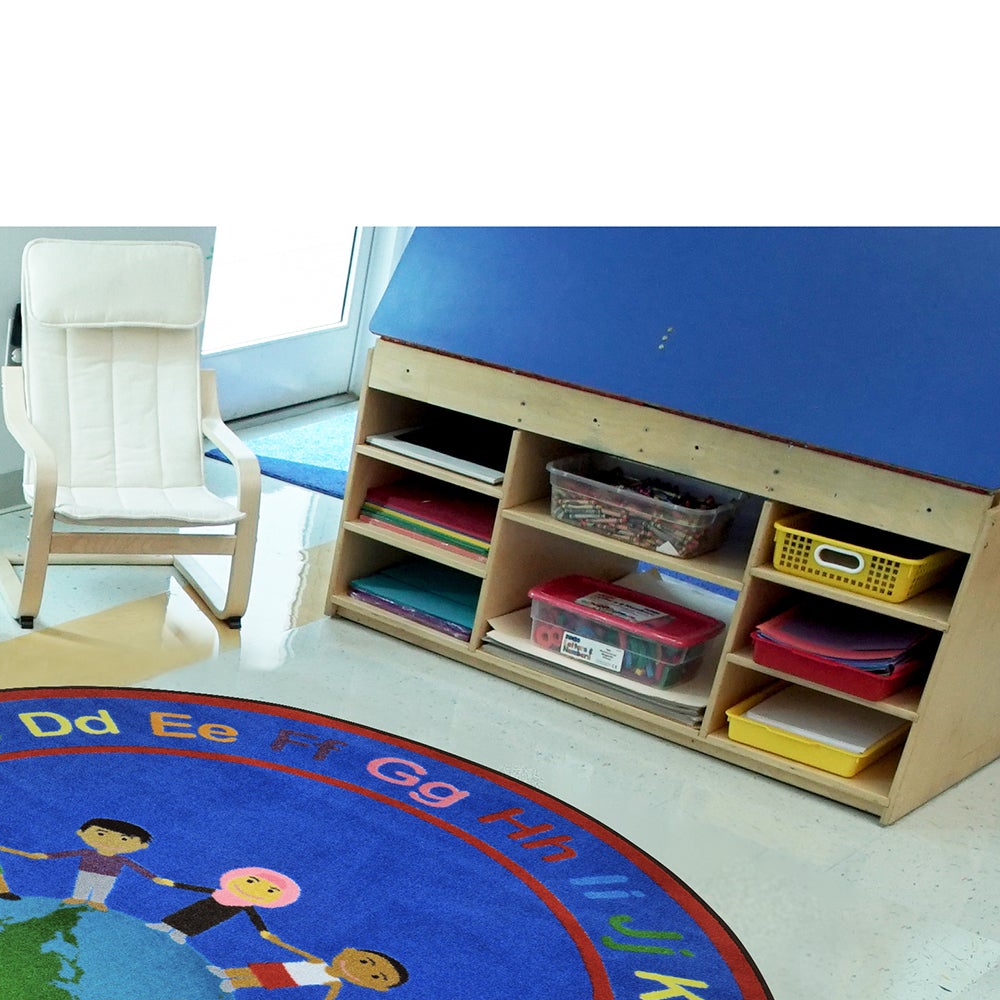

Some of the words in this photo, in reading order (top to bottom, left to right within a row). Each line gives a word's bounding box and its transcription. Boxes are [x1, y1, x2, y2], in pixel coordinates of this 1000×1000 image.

[18, 709, 120, 738] Dd
[149, 711, 239, 744] Ee
[270, 729, 349, 762] Ff
[366, 757, 471, 808] Gg
[477, 807, 577, 863] Hh
[569, 875, 646, 899] Ii
[601, 914, 696, 957] Jj
